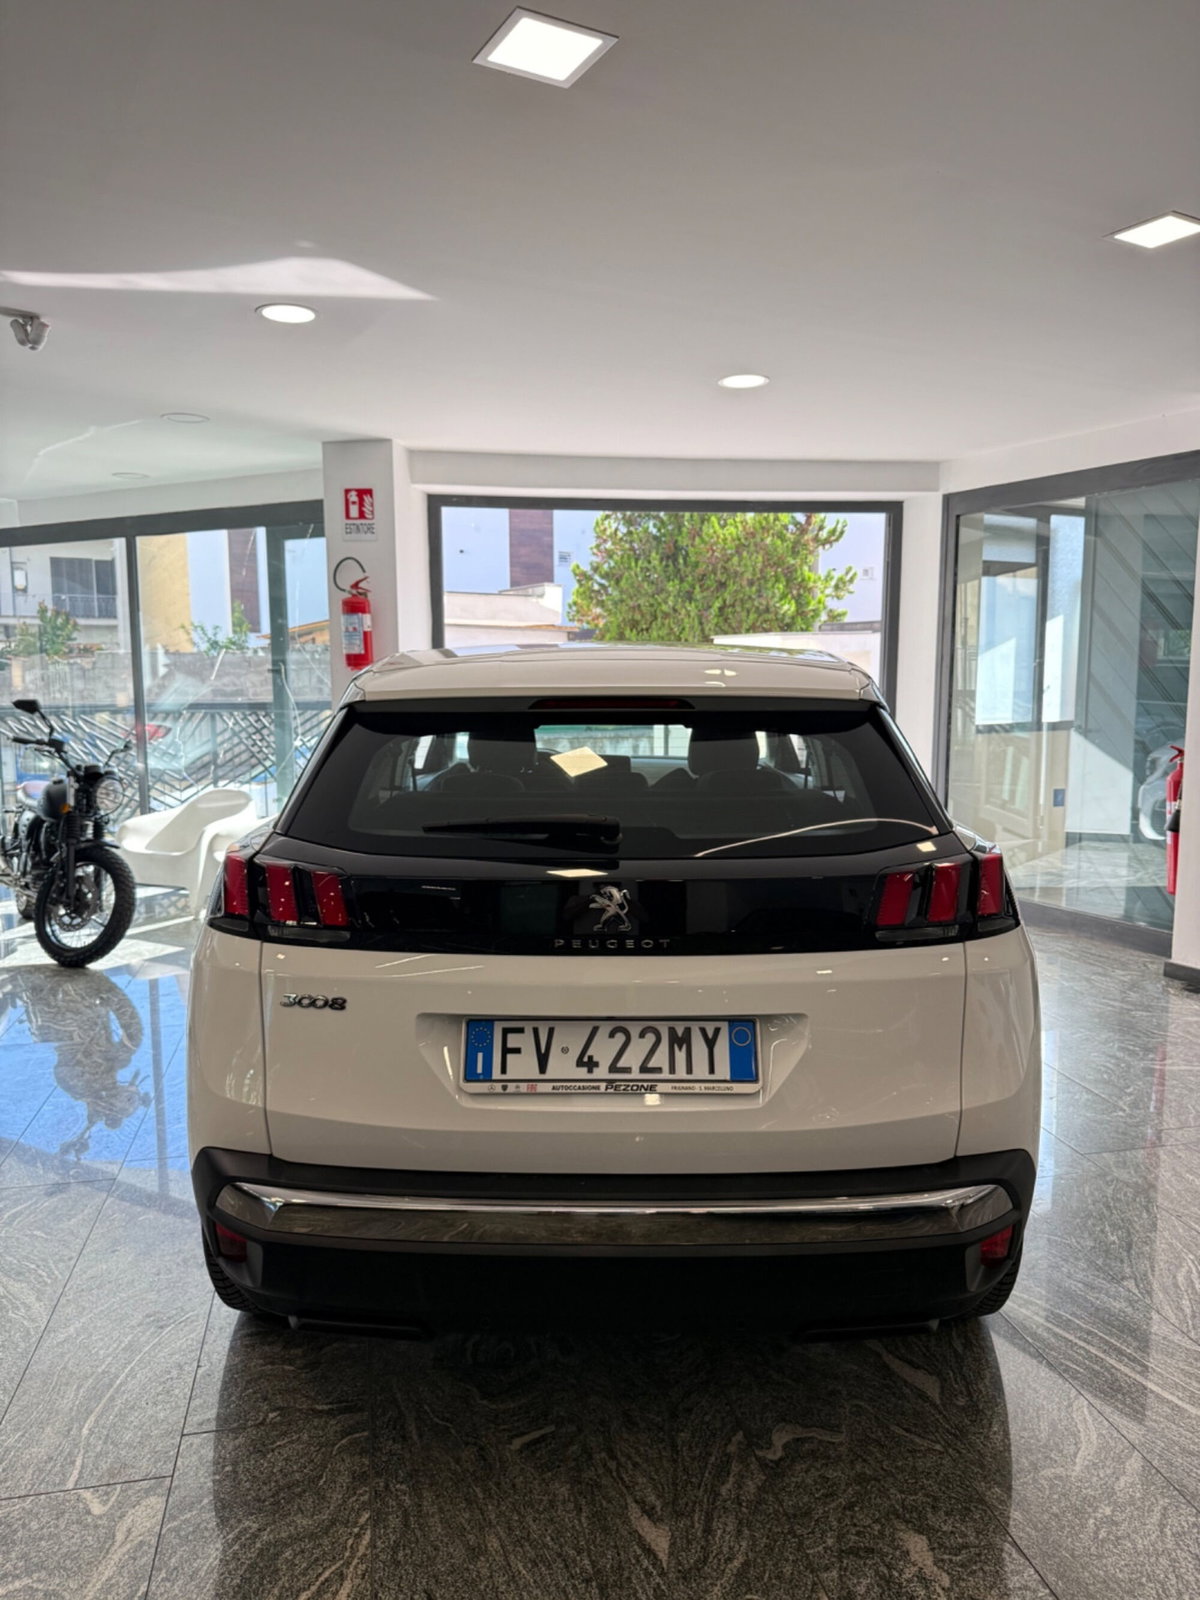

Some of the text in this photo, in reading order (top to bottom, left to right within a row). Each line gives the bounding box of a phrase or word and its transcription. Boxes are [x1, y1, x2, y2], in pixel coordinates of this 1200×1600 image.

[345, 523, 375, 534] ESTINTORE
[554, 939, 670, 949] PEUGEOT
[280, 993, 347, 1011] 3008
[500, 1026, 722, 1075] FV 422MY
[604, 1083, 658, 1092] PEZONE
